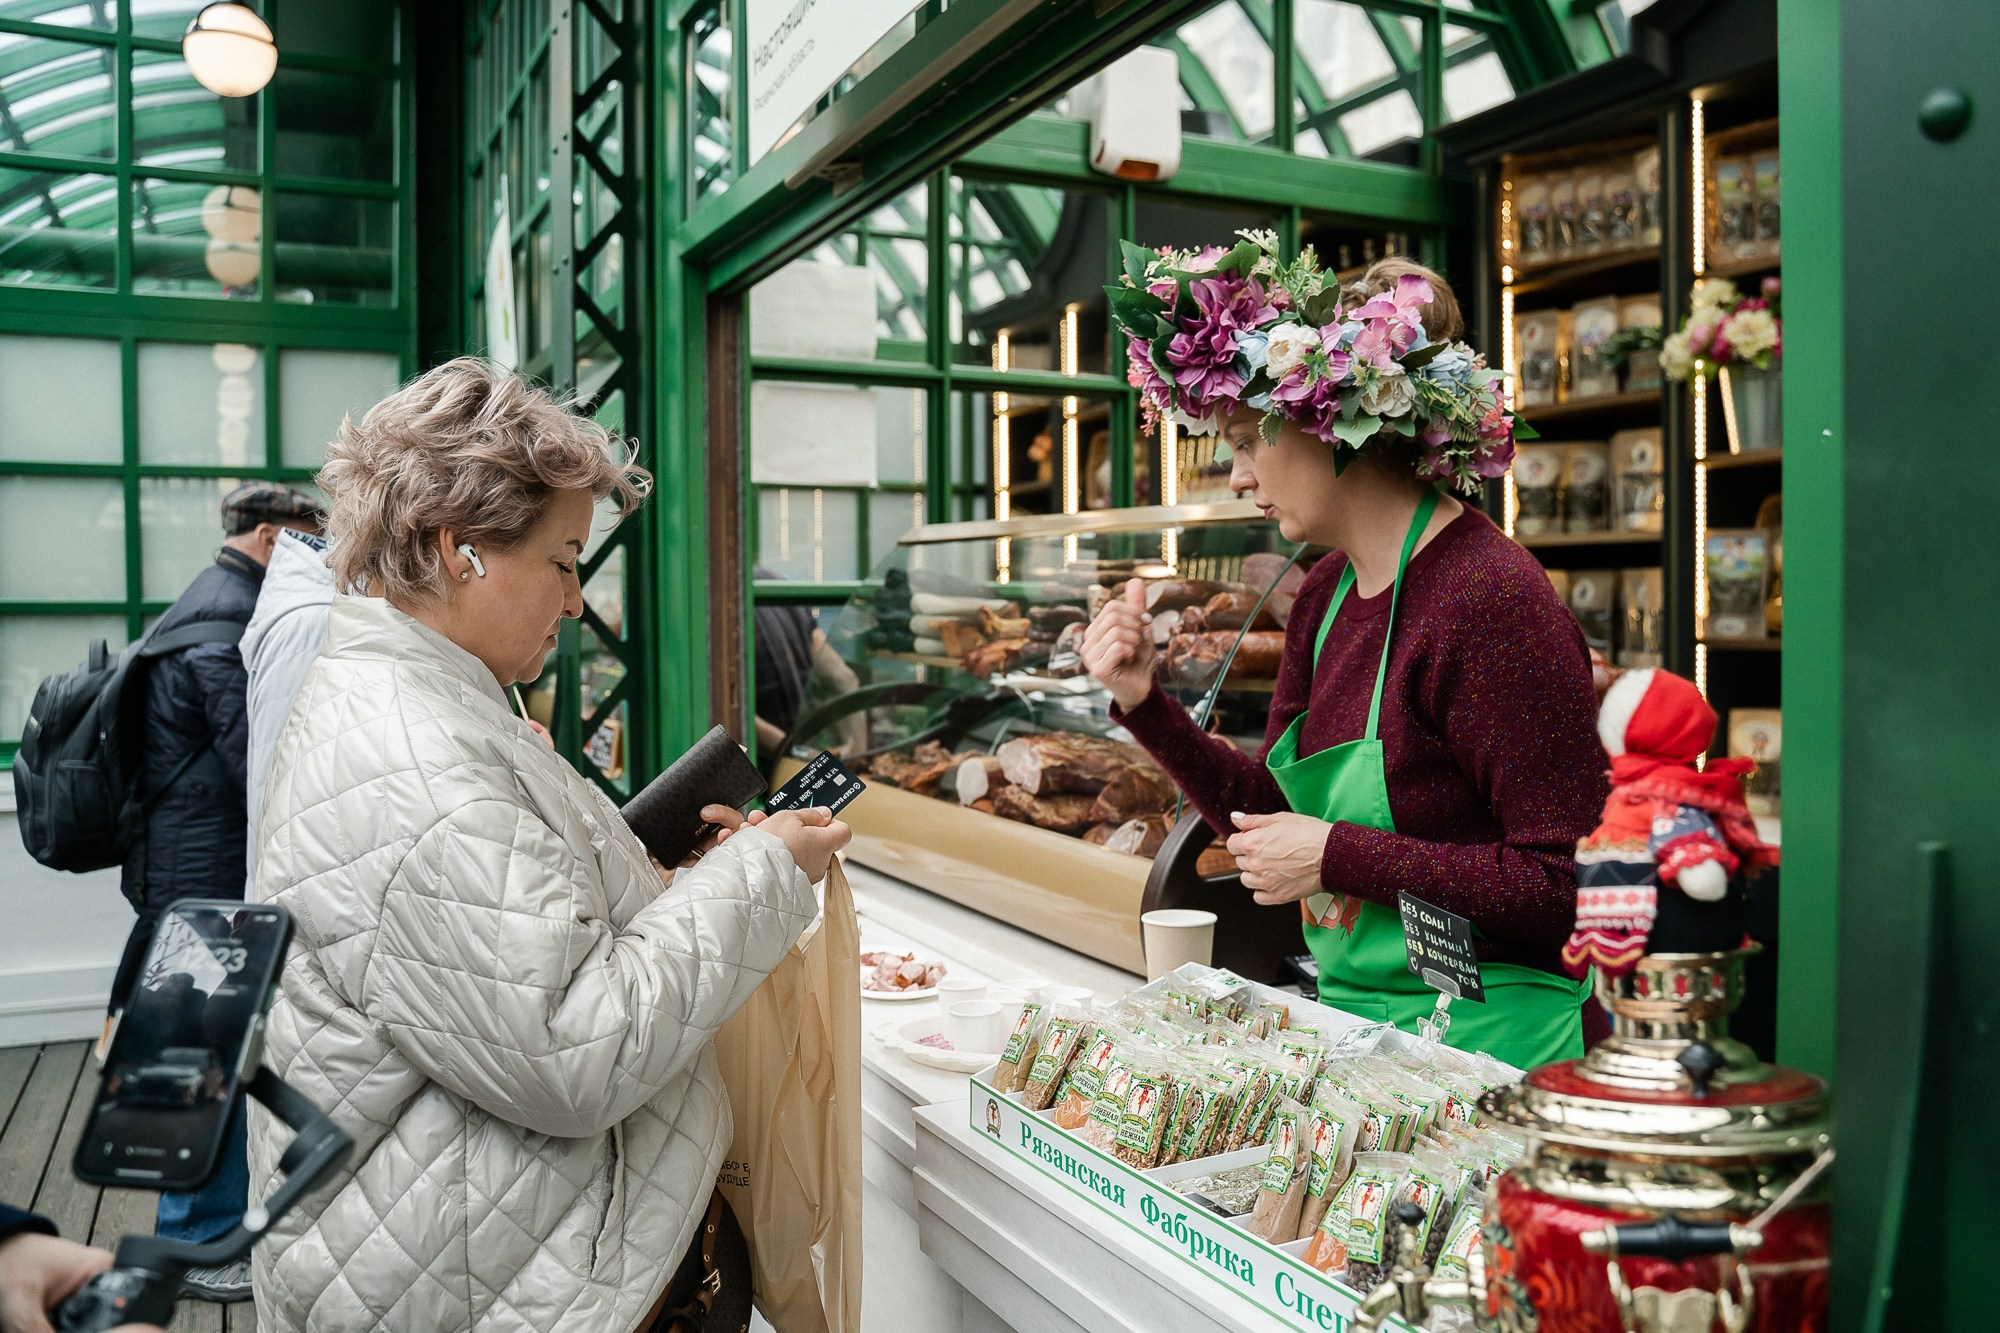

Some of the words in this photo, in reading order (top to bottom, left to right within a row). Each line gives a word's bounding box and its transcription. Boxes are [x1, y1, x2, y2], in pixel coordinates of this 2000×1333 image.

[768, 791, 788, 806] VISA
[1400, 899, 1418, 918] БЕЗ
[1403, 919, 1420, 937] БЕЗ
[1406, 938, 1424, 956] БЕЗ
[1456, 973, 1479, 989] ТОВ
[1091, 1106, 1119, 1122] ГРИБНАЯ
[1119, 1129, 1146, 1144] НЕЖНАЯ
[1019, 1120, 1126, 1208] Рязанская
[1140, 1193, 1255, 1287] Фабрика
